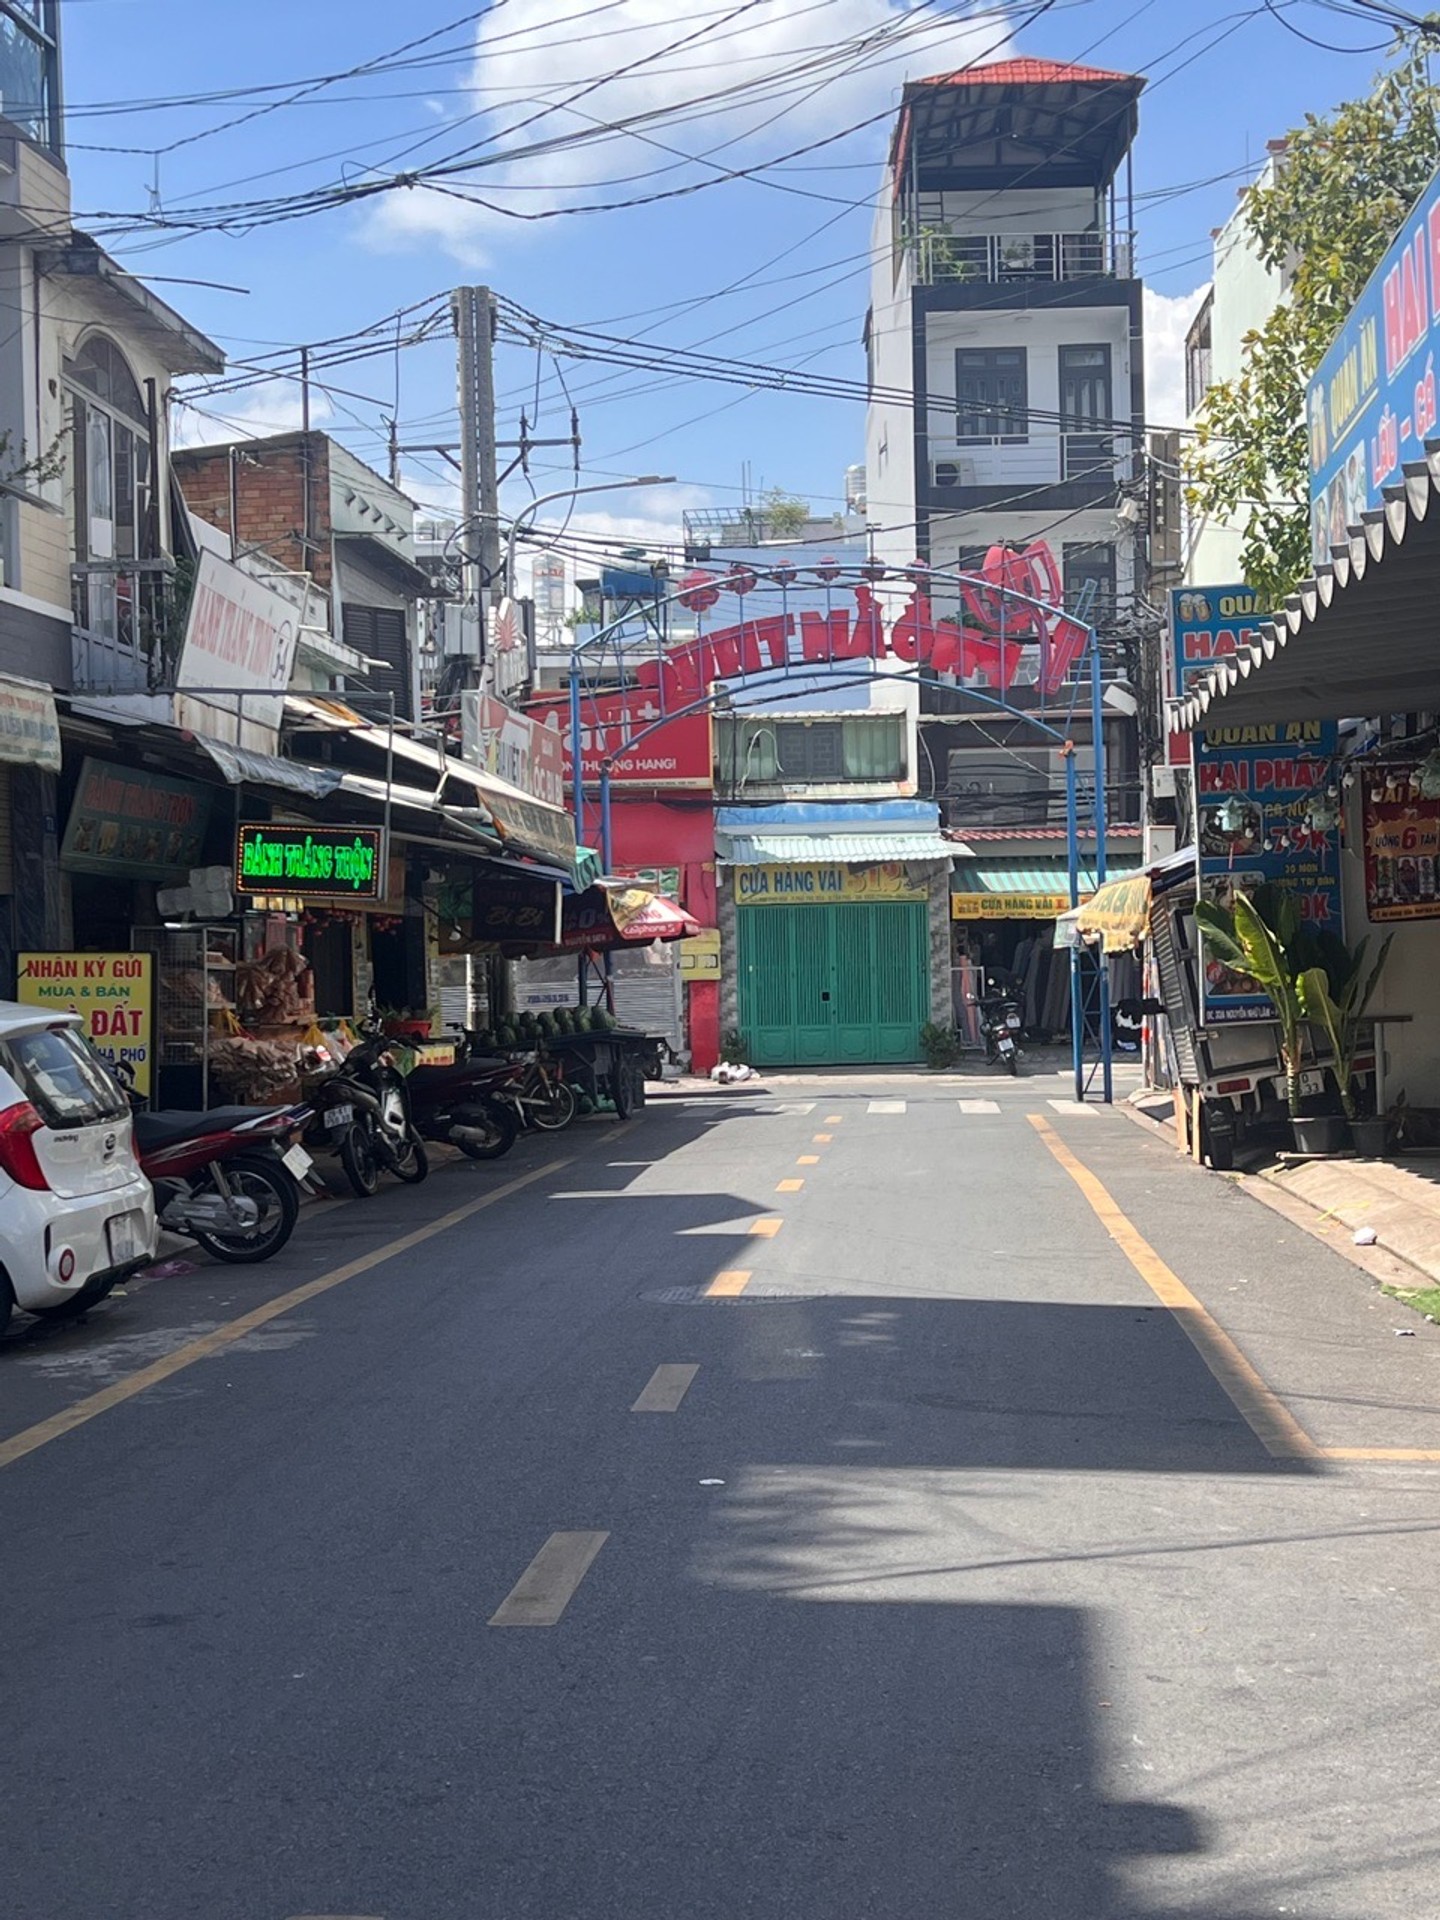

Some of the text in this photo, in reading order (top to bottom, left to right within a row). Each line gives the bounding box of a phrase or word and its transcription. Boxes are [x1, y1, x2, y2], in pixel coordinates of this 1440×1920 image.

[1402, 826, 1418, 849] 6
[242, 833, 374, 889] BÁNH TRÁNG TRỘN
[774, 866, 814, 892] HÀNG
[27, 954, 142, 982] NHẬN KÝ GỬI
[38, 982, 131, 997] MUA & BÁN
[91, 1001, 143, 1037] ĐẤT
